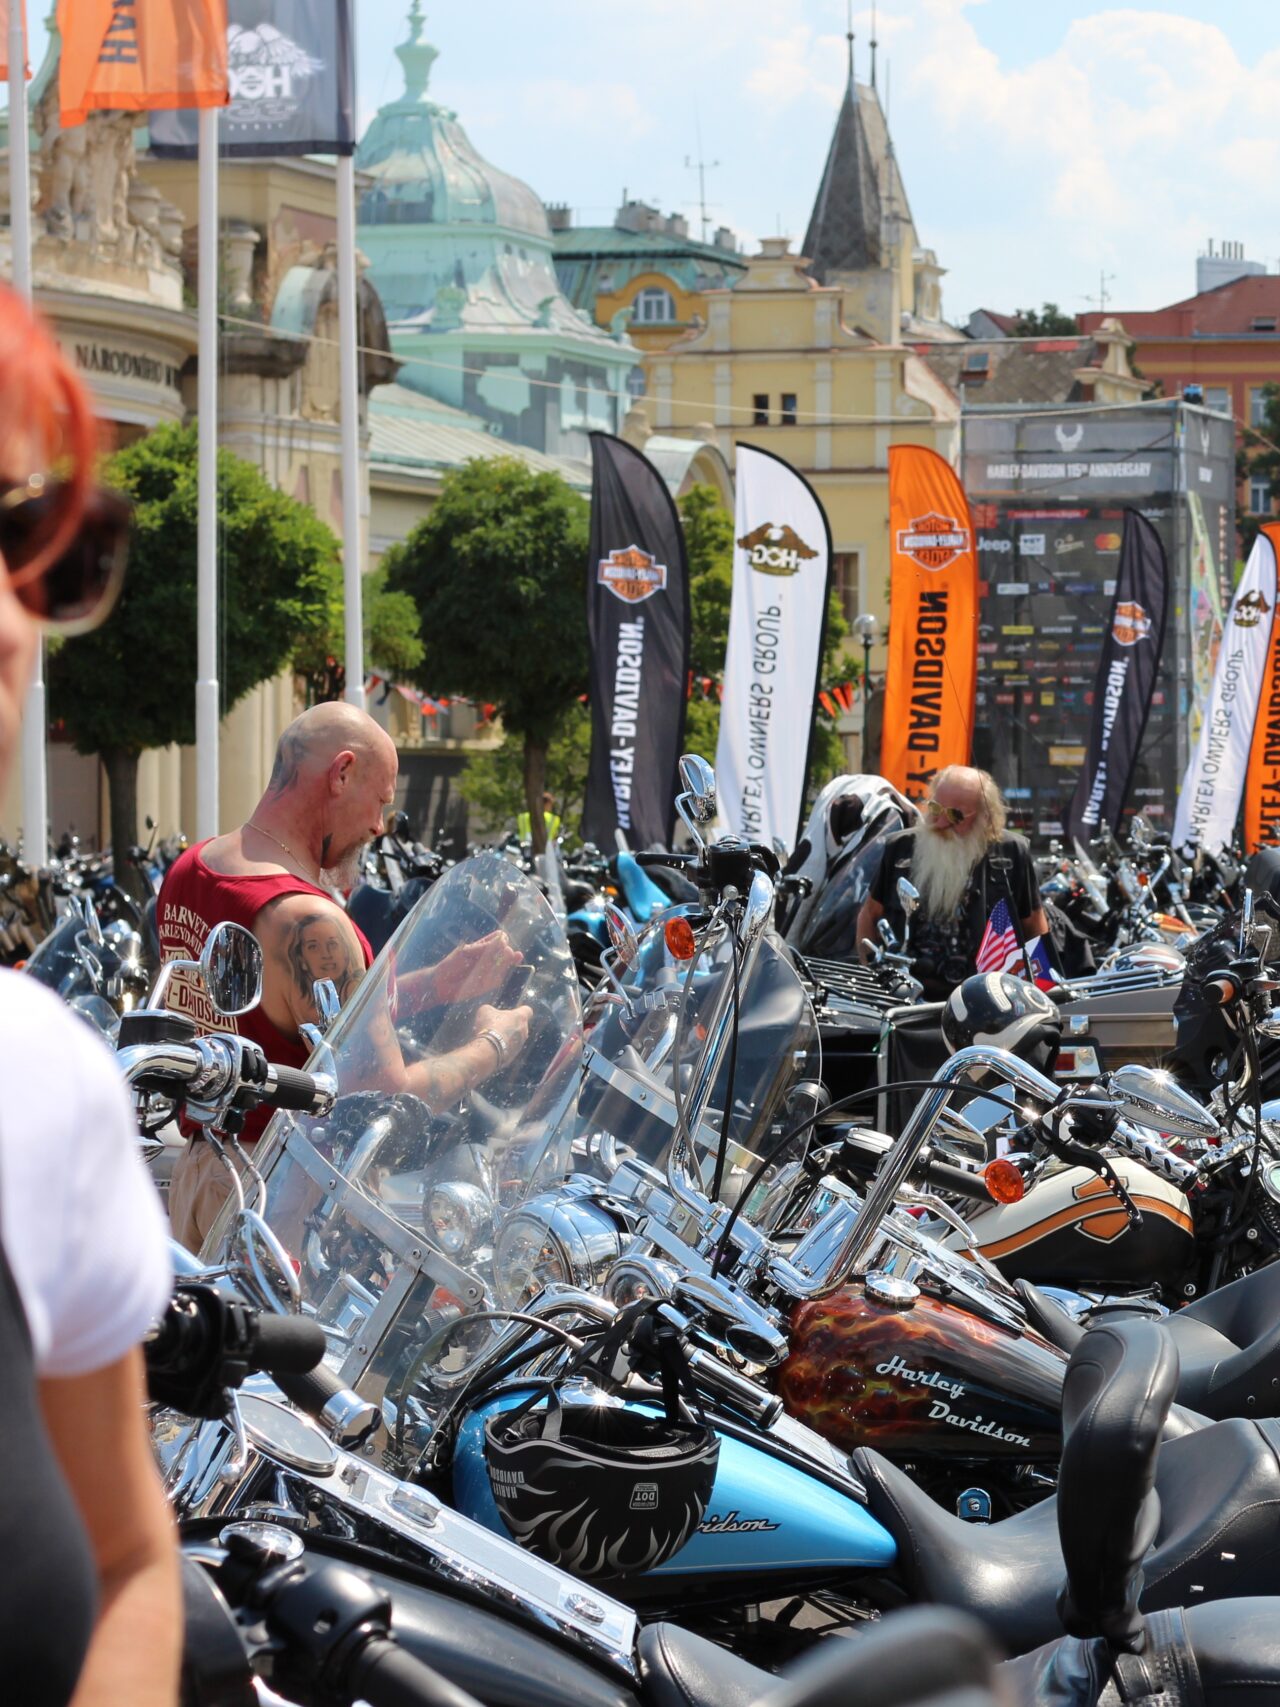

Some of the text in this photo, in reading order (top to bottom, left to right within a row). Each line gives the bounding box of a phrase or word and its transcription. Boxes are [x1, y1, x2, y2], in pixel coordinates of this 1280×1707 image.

[976, 536, 1012, 553] Jeep
[163, 903, 212, 940] BARNET
[875, 1355, 966, 1399] Harley
[928, 1399, 1031, 1448] Davidson
[634, 1491, 656, 1501] DOT
